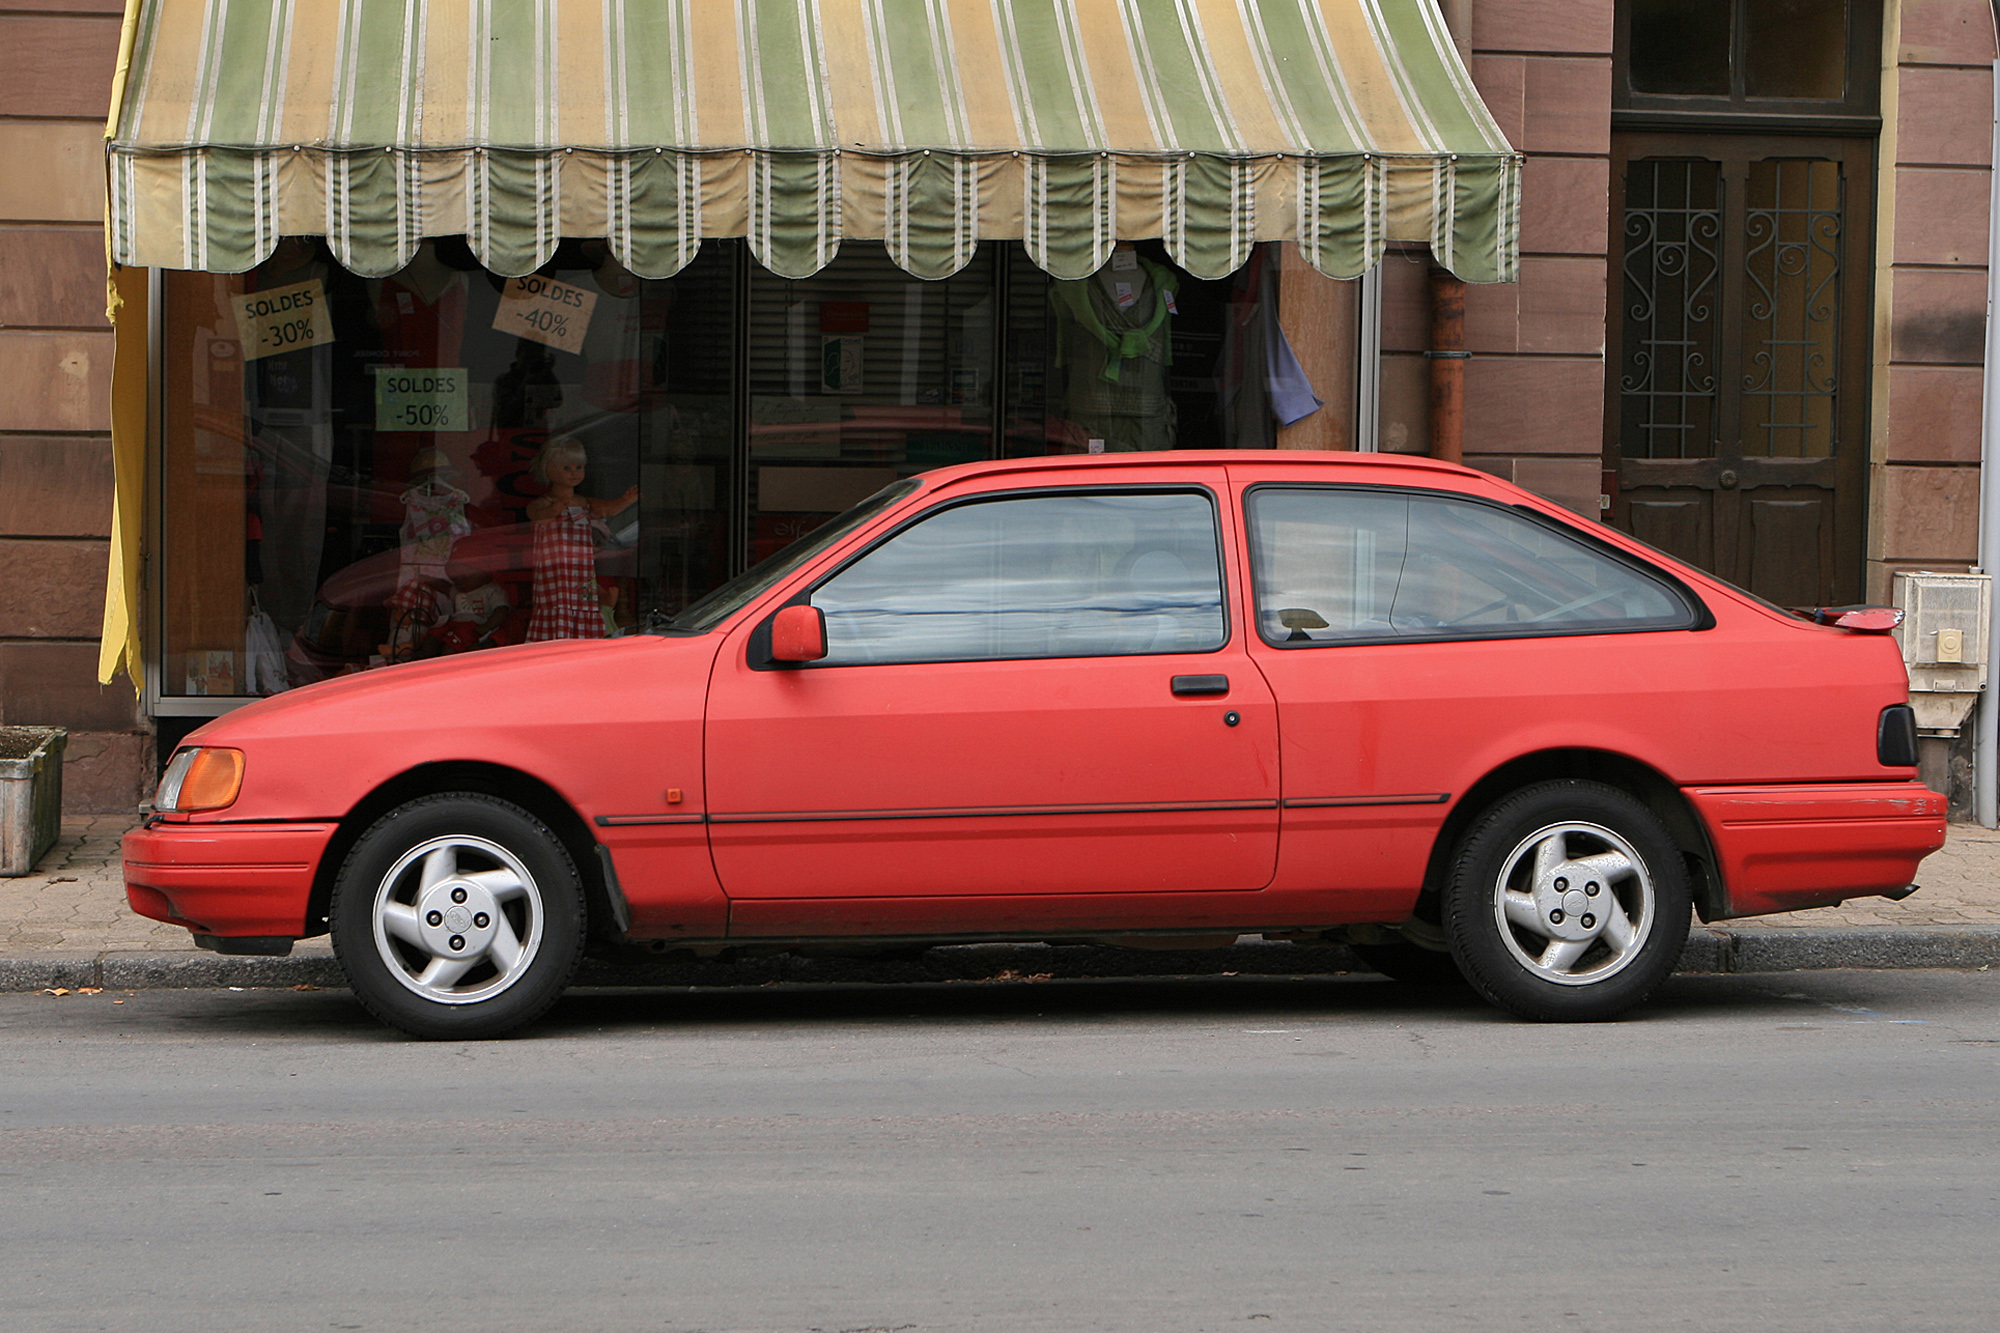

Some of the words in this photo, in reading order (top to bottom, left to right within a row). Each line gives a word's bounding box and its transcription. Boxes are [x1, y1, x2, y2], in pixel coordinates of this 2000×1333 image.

[245, 290, 313, 318] SOLDES
[517, 276, 584, 307] SOLDES
[261, 318, 314, 346] -30%
[516, 308, 569, 337] -40%
[387, 377, 456, 393] SOLDES
[396, 404, 449, 425] -50%
